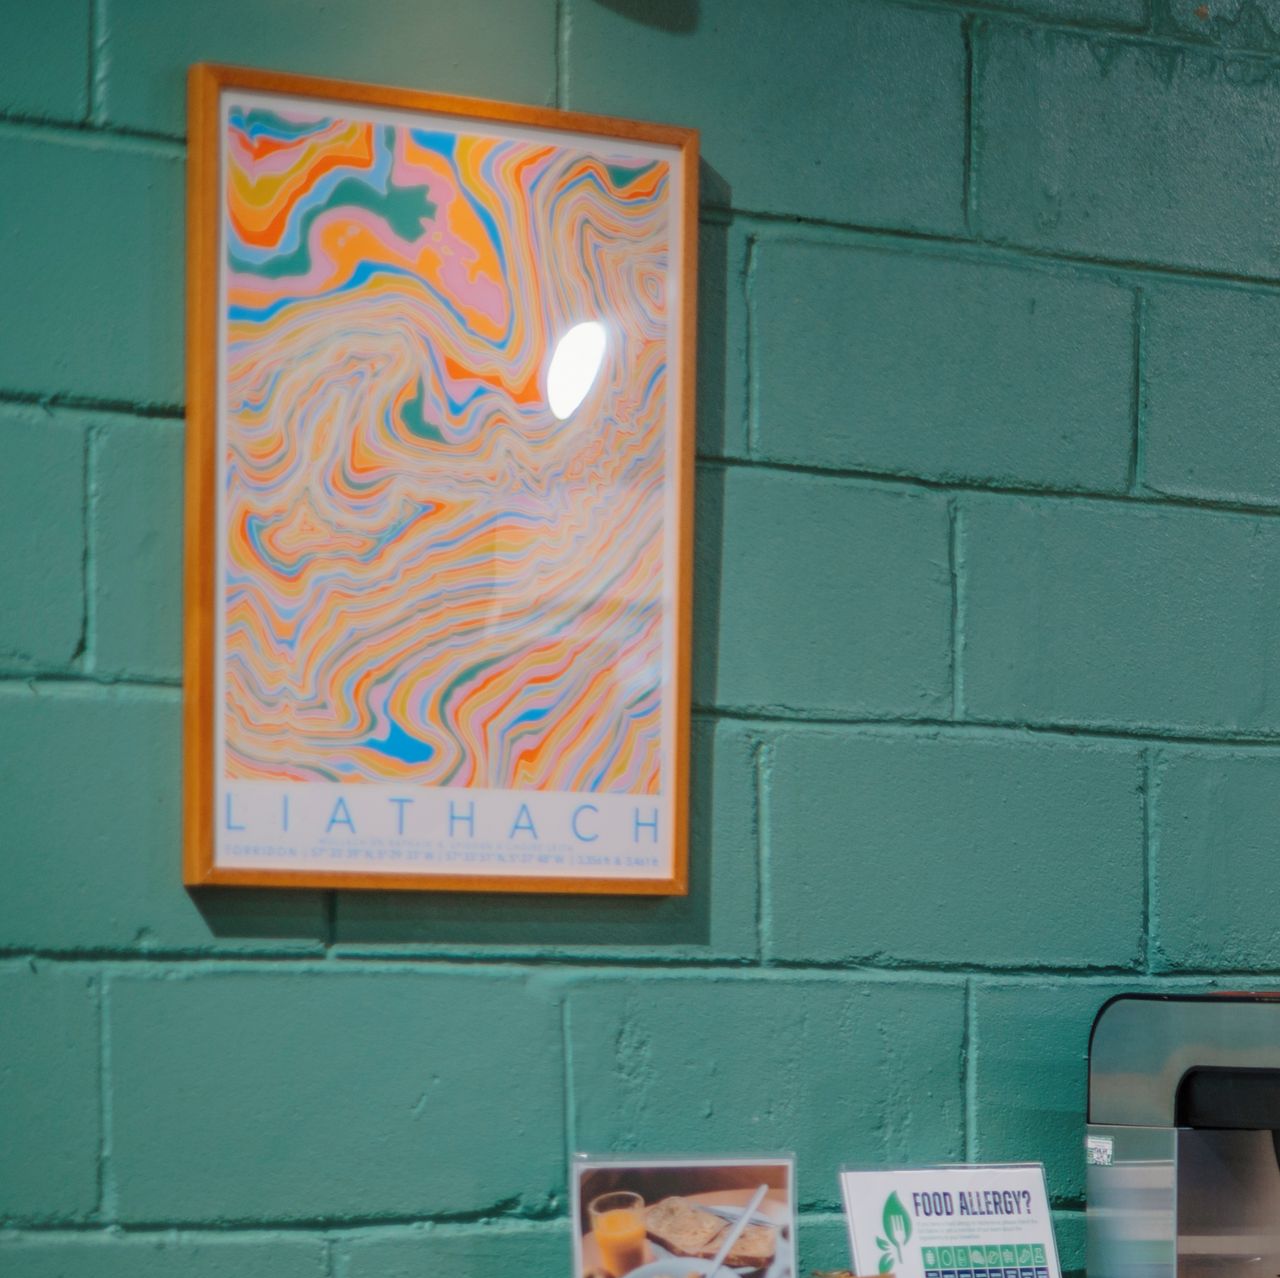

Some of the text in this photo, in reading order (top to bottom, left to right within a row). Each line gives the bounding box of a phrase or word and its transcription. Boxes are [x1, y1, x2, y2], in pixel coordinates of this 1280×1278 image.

[225, 792, 659, 844] LIATHACH
[912, 1190, 1032, 1217] FOOD ALLERGY?
